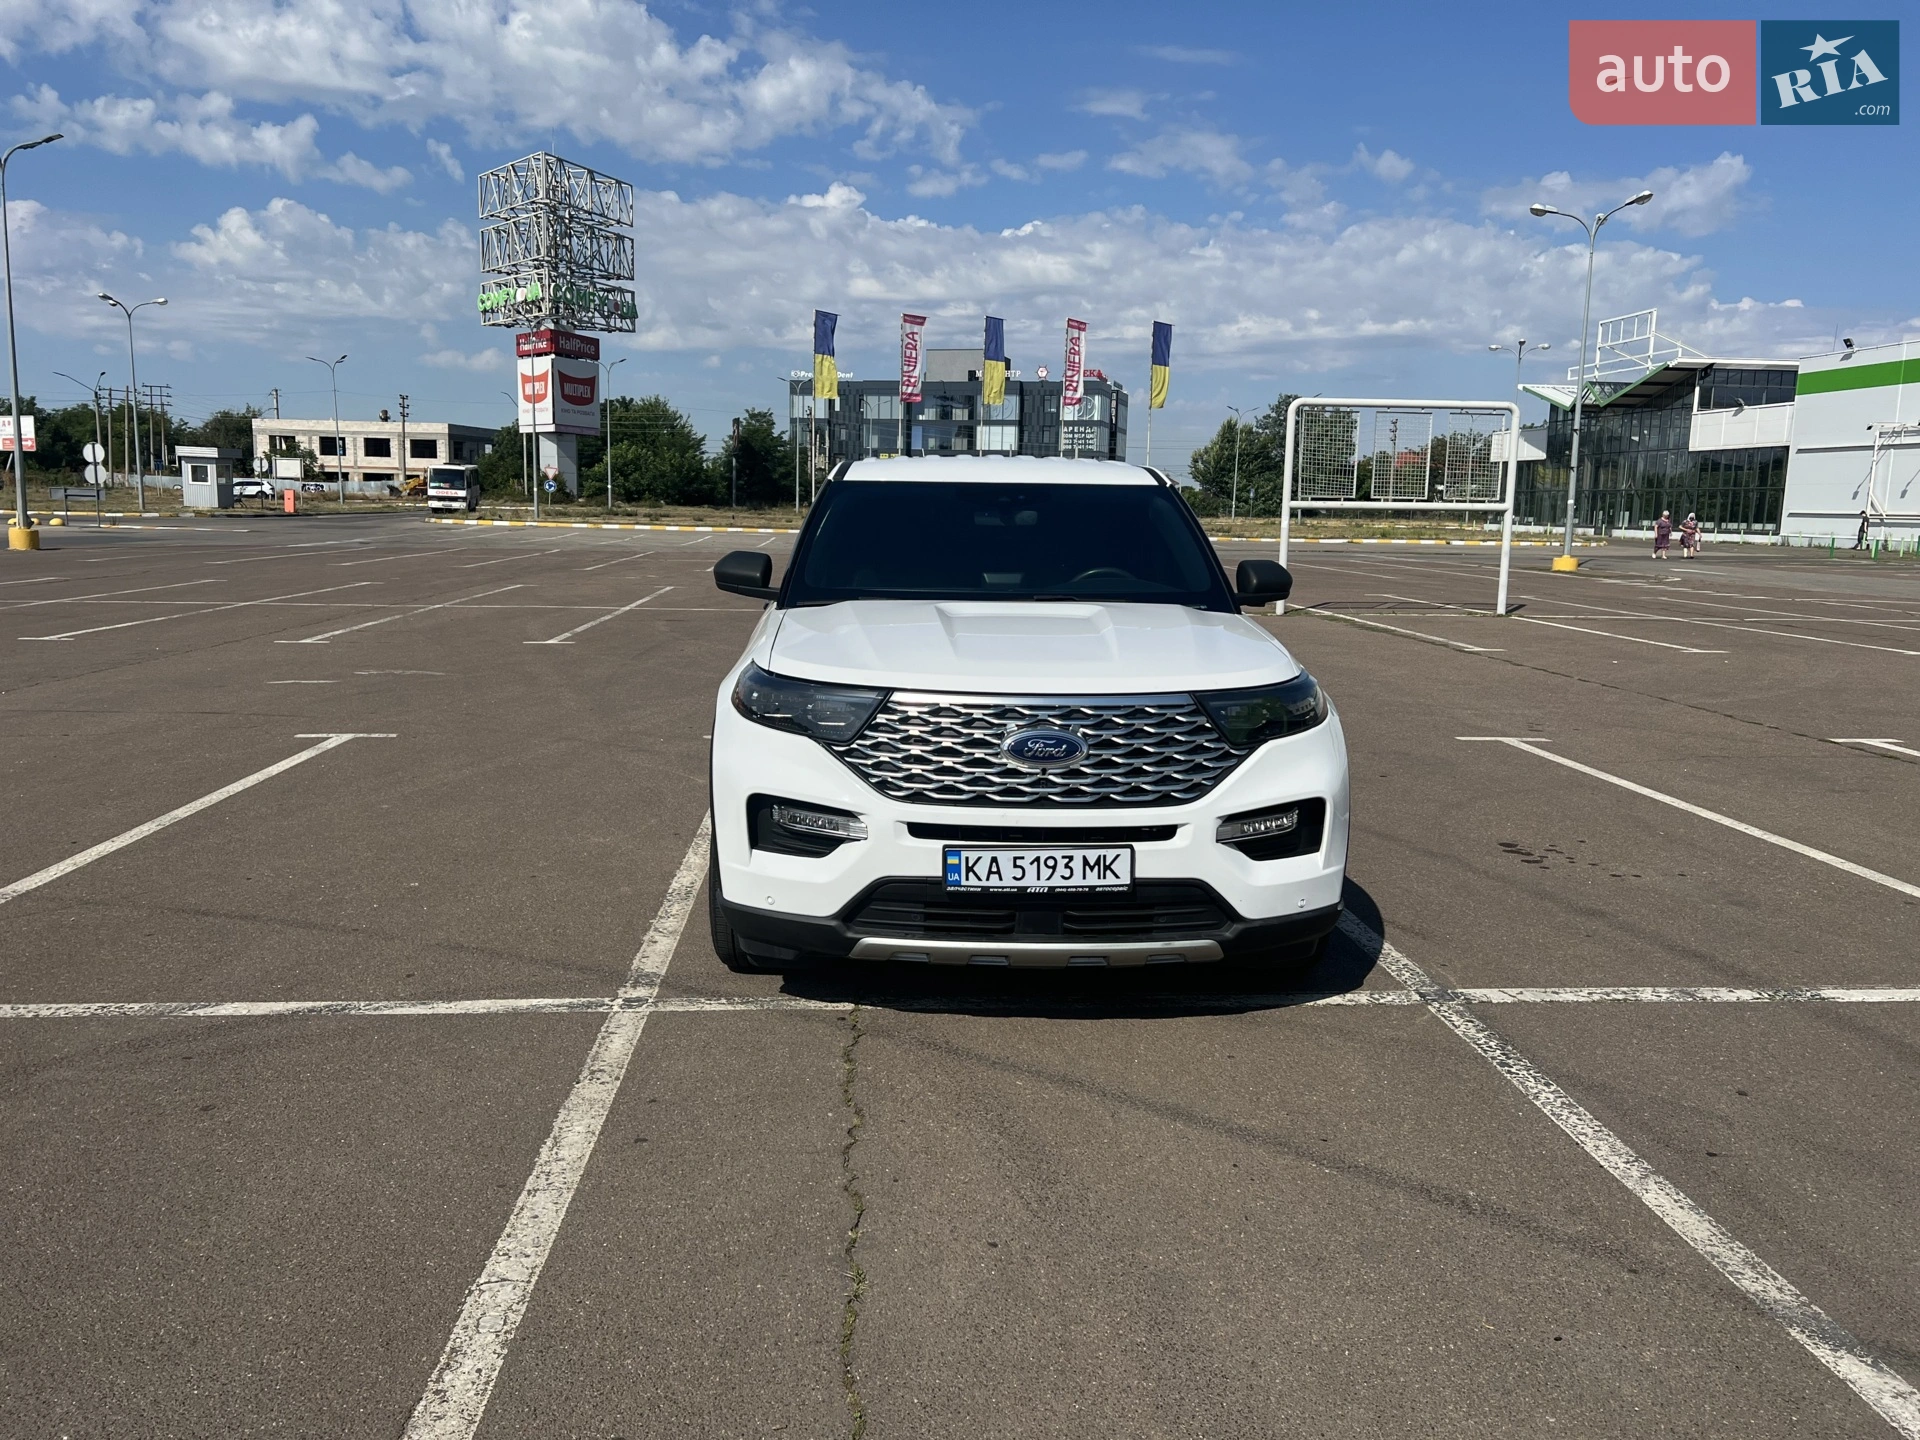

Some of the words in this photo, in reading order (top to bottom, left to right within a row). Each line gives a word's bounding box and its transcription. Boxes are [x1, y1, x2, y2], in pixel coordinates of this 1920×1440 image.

[559, 335, 595, 354] HalfPrice
[563, 382, 591, 398] MULTIPLEX
[1024, 738, 1067, 758] Ford
[947, 872, 960, 881] UA
[964, 855, 1004, 882] KA
[1012, 855, 1074, 881] 5193
[1082, 853, 1121, 880] MK
